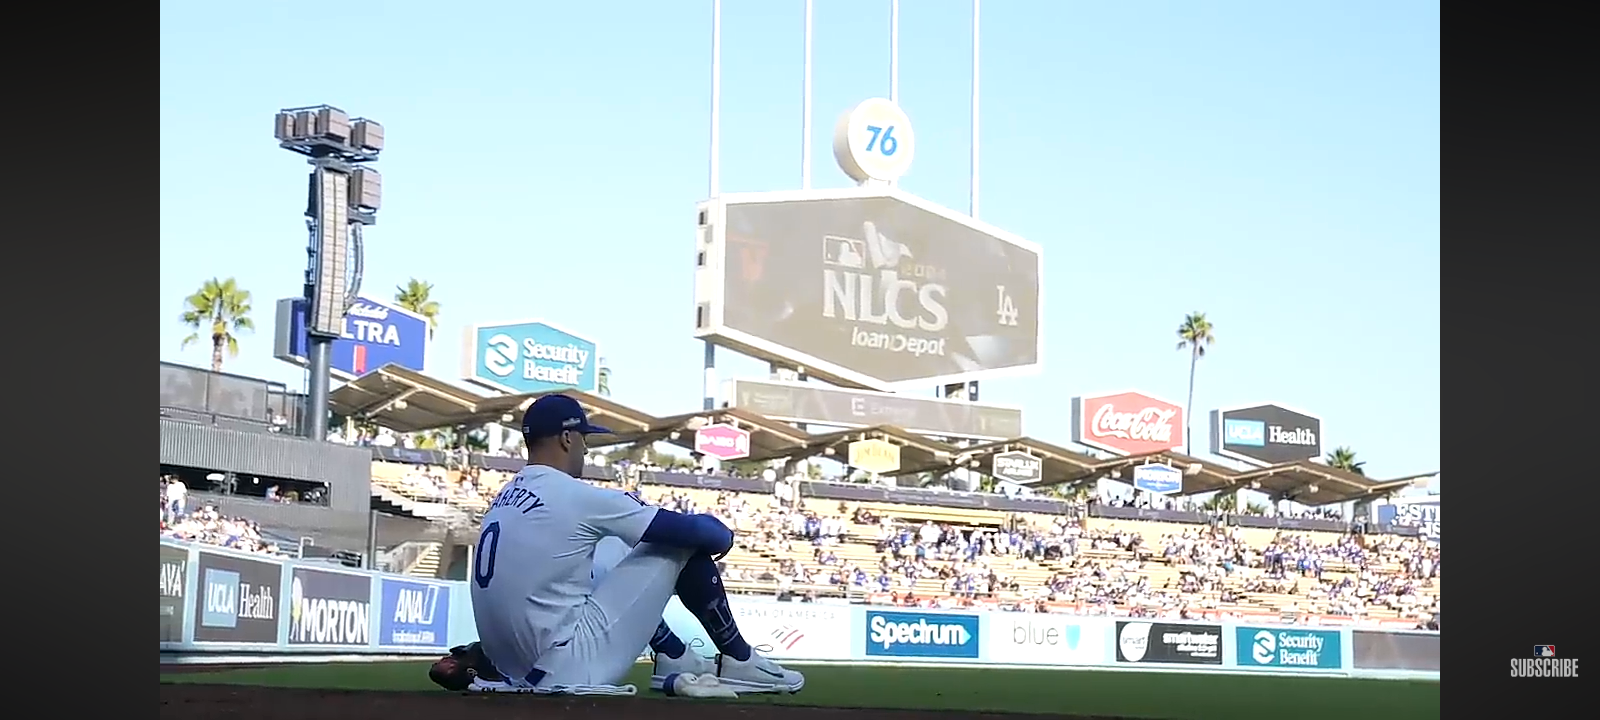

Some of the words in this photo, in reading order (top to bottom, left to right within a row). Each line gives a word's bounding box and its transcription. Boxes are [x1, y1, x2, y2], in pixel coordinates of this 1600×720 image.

[865, 124, 898, 156] 76
[822, 268, 949, 332] NLCS
[996, 284, 1019, 326] LA
[522, 337, 589, 370] Security
[522, 358, 583, 385] Benefit
[1228, 424, 1263, 440] UCLA
[1268, 425, 1317, 446] Health
[1396, 502, 1440, 522] EST
[475, 521, 501, 589] 0
[208, 581, 235, 615] UCLA
[238, 582, 275, 620] Health
[393, 588, 425, 625] ANA
[740, 607, 768, 618] BANK
[788, 610, 836, 621] AMERICA
[300, 597, 370, 645] MORTON
[870, 615, 966, 650] Spectrum
[1013, 620, 1060, 646] blue
[1278, 631, 1324, 653] Security
[1279, 648, 1321, 666] Benefit
